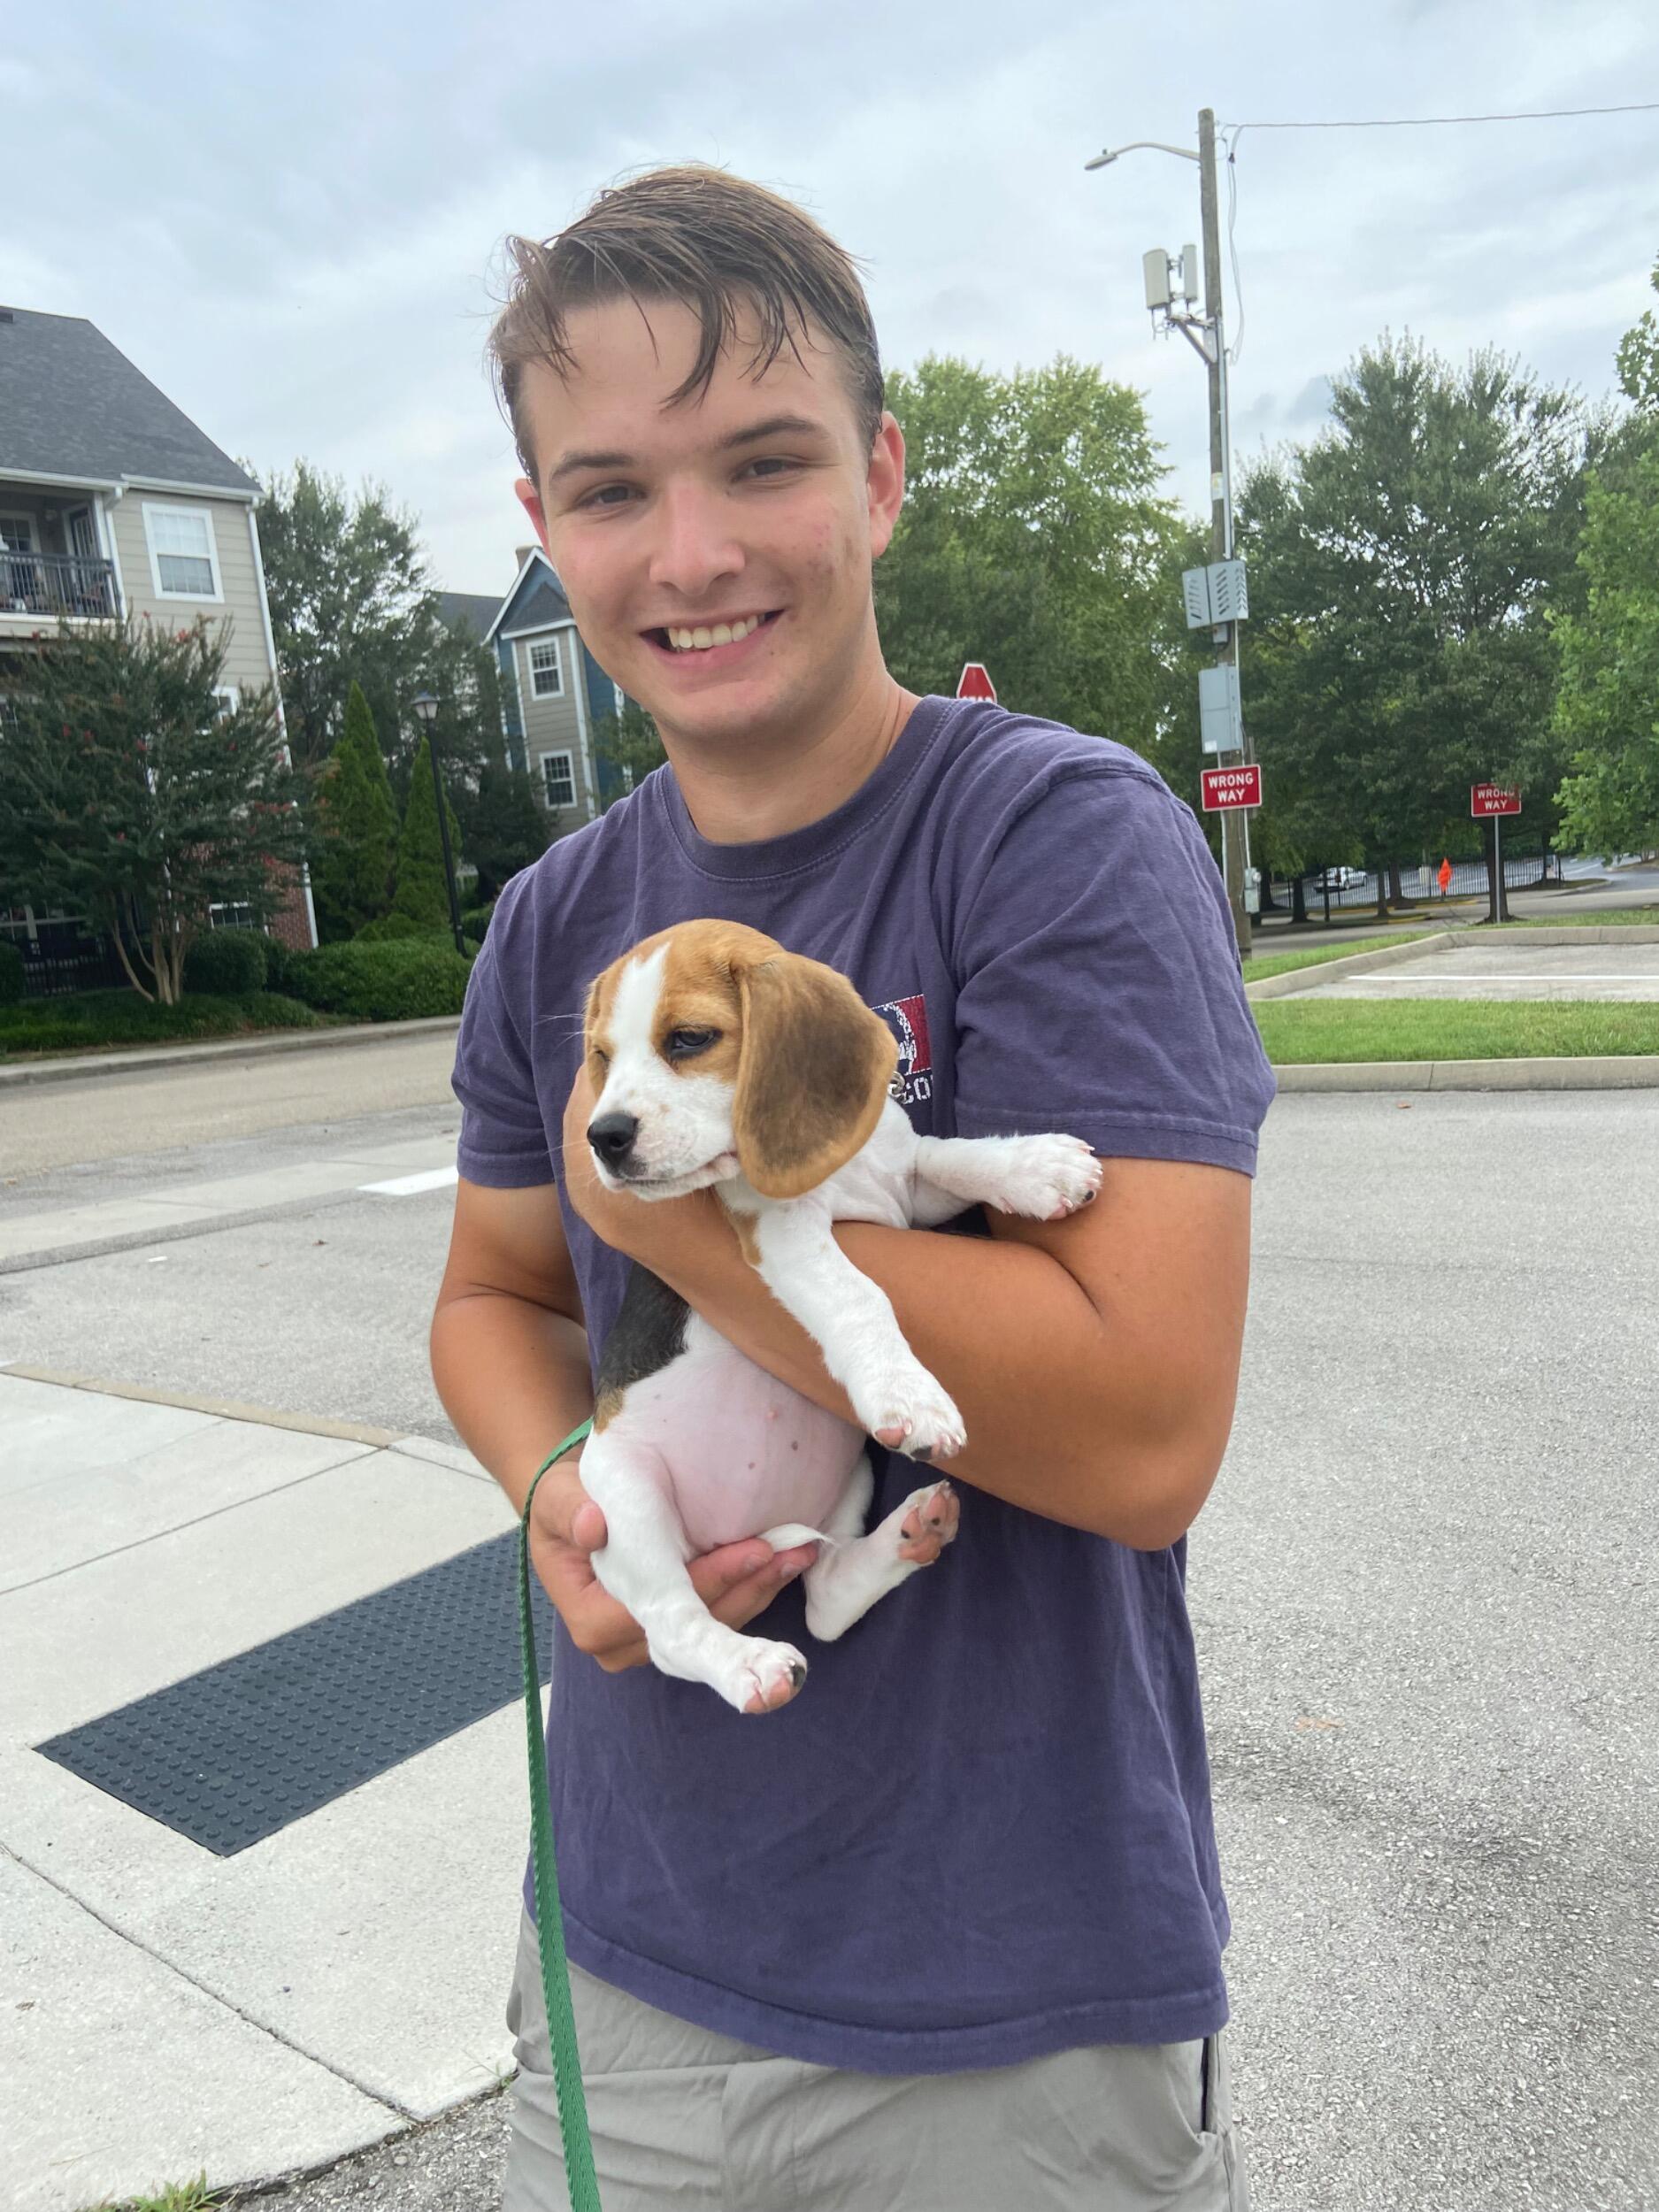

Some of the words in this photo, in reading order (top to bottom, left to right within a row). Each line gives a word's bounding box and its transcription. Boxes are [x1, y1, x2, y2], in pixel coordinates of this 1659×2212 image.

[1209, 772, 1254, 788] WRONG
[1217, 788, 1245, 803] WAY
[1485, 800, 1508, 810] WAY
